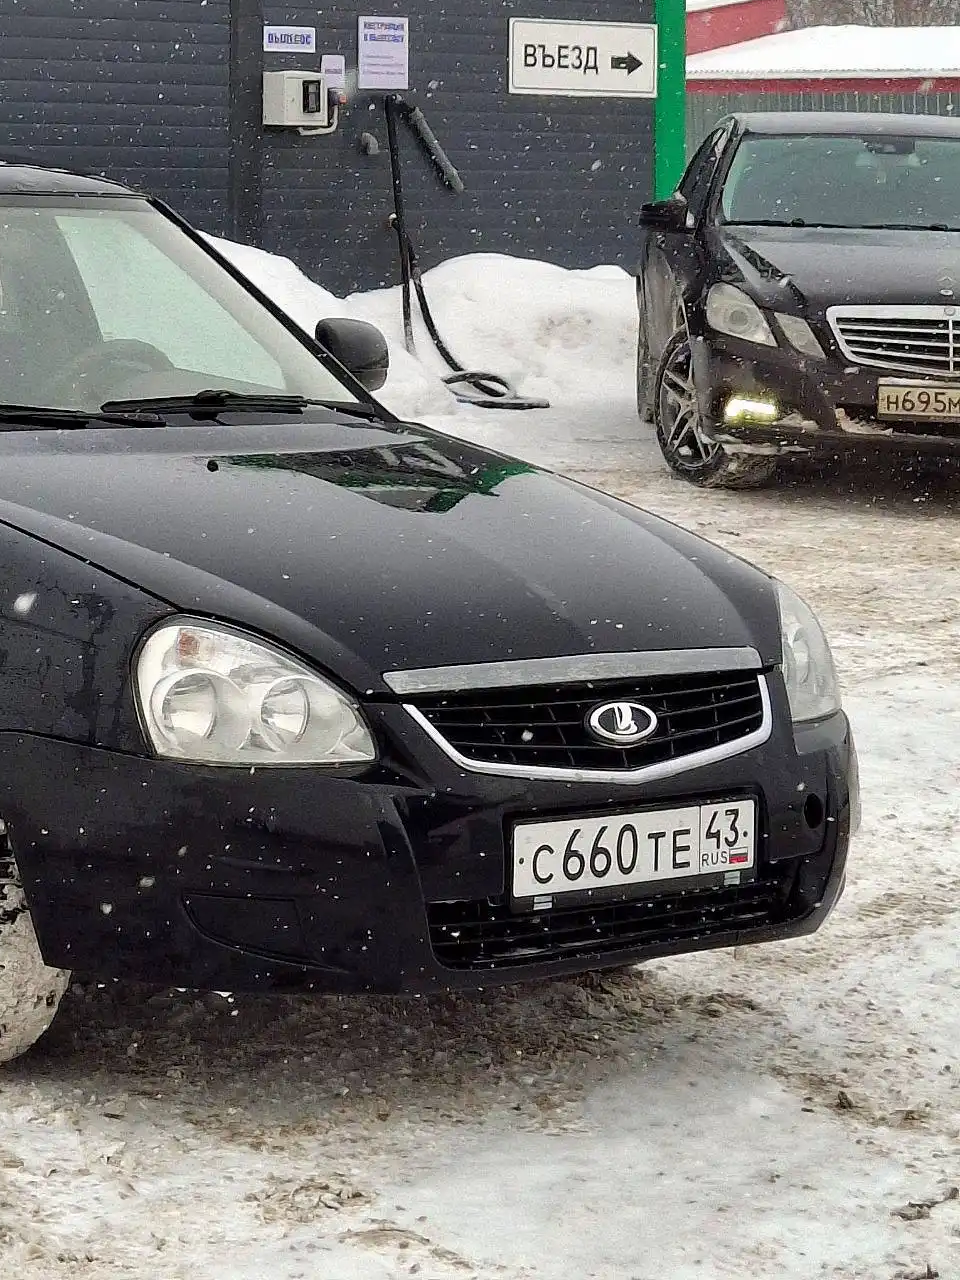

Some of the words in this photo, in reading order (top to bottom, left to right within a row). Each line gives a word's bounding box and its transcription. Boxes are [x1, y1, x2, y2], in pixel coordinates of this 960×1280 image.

[524, 43, 599, 75] ВЪЕЗД
[705, 808, 740, 849] 43
[701, 850, 728, 867] RUS
